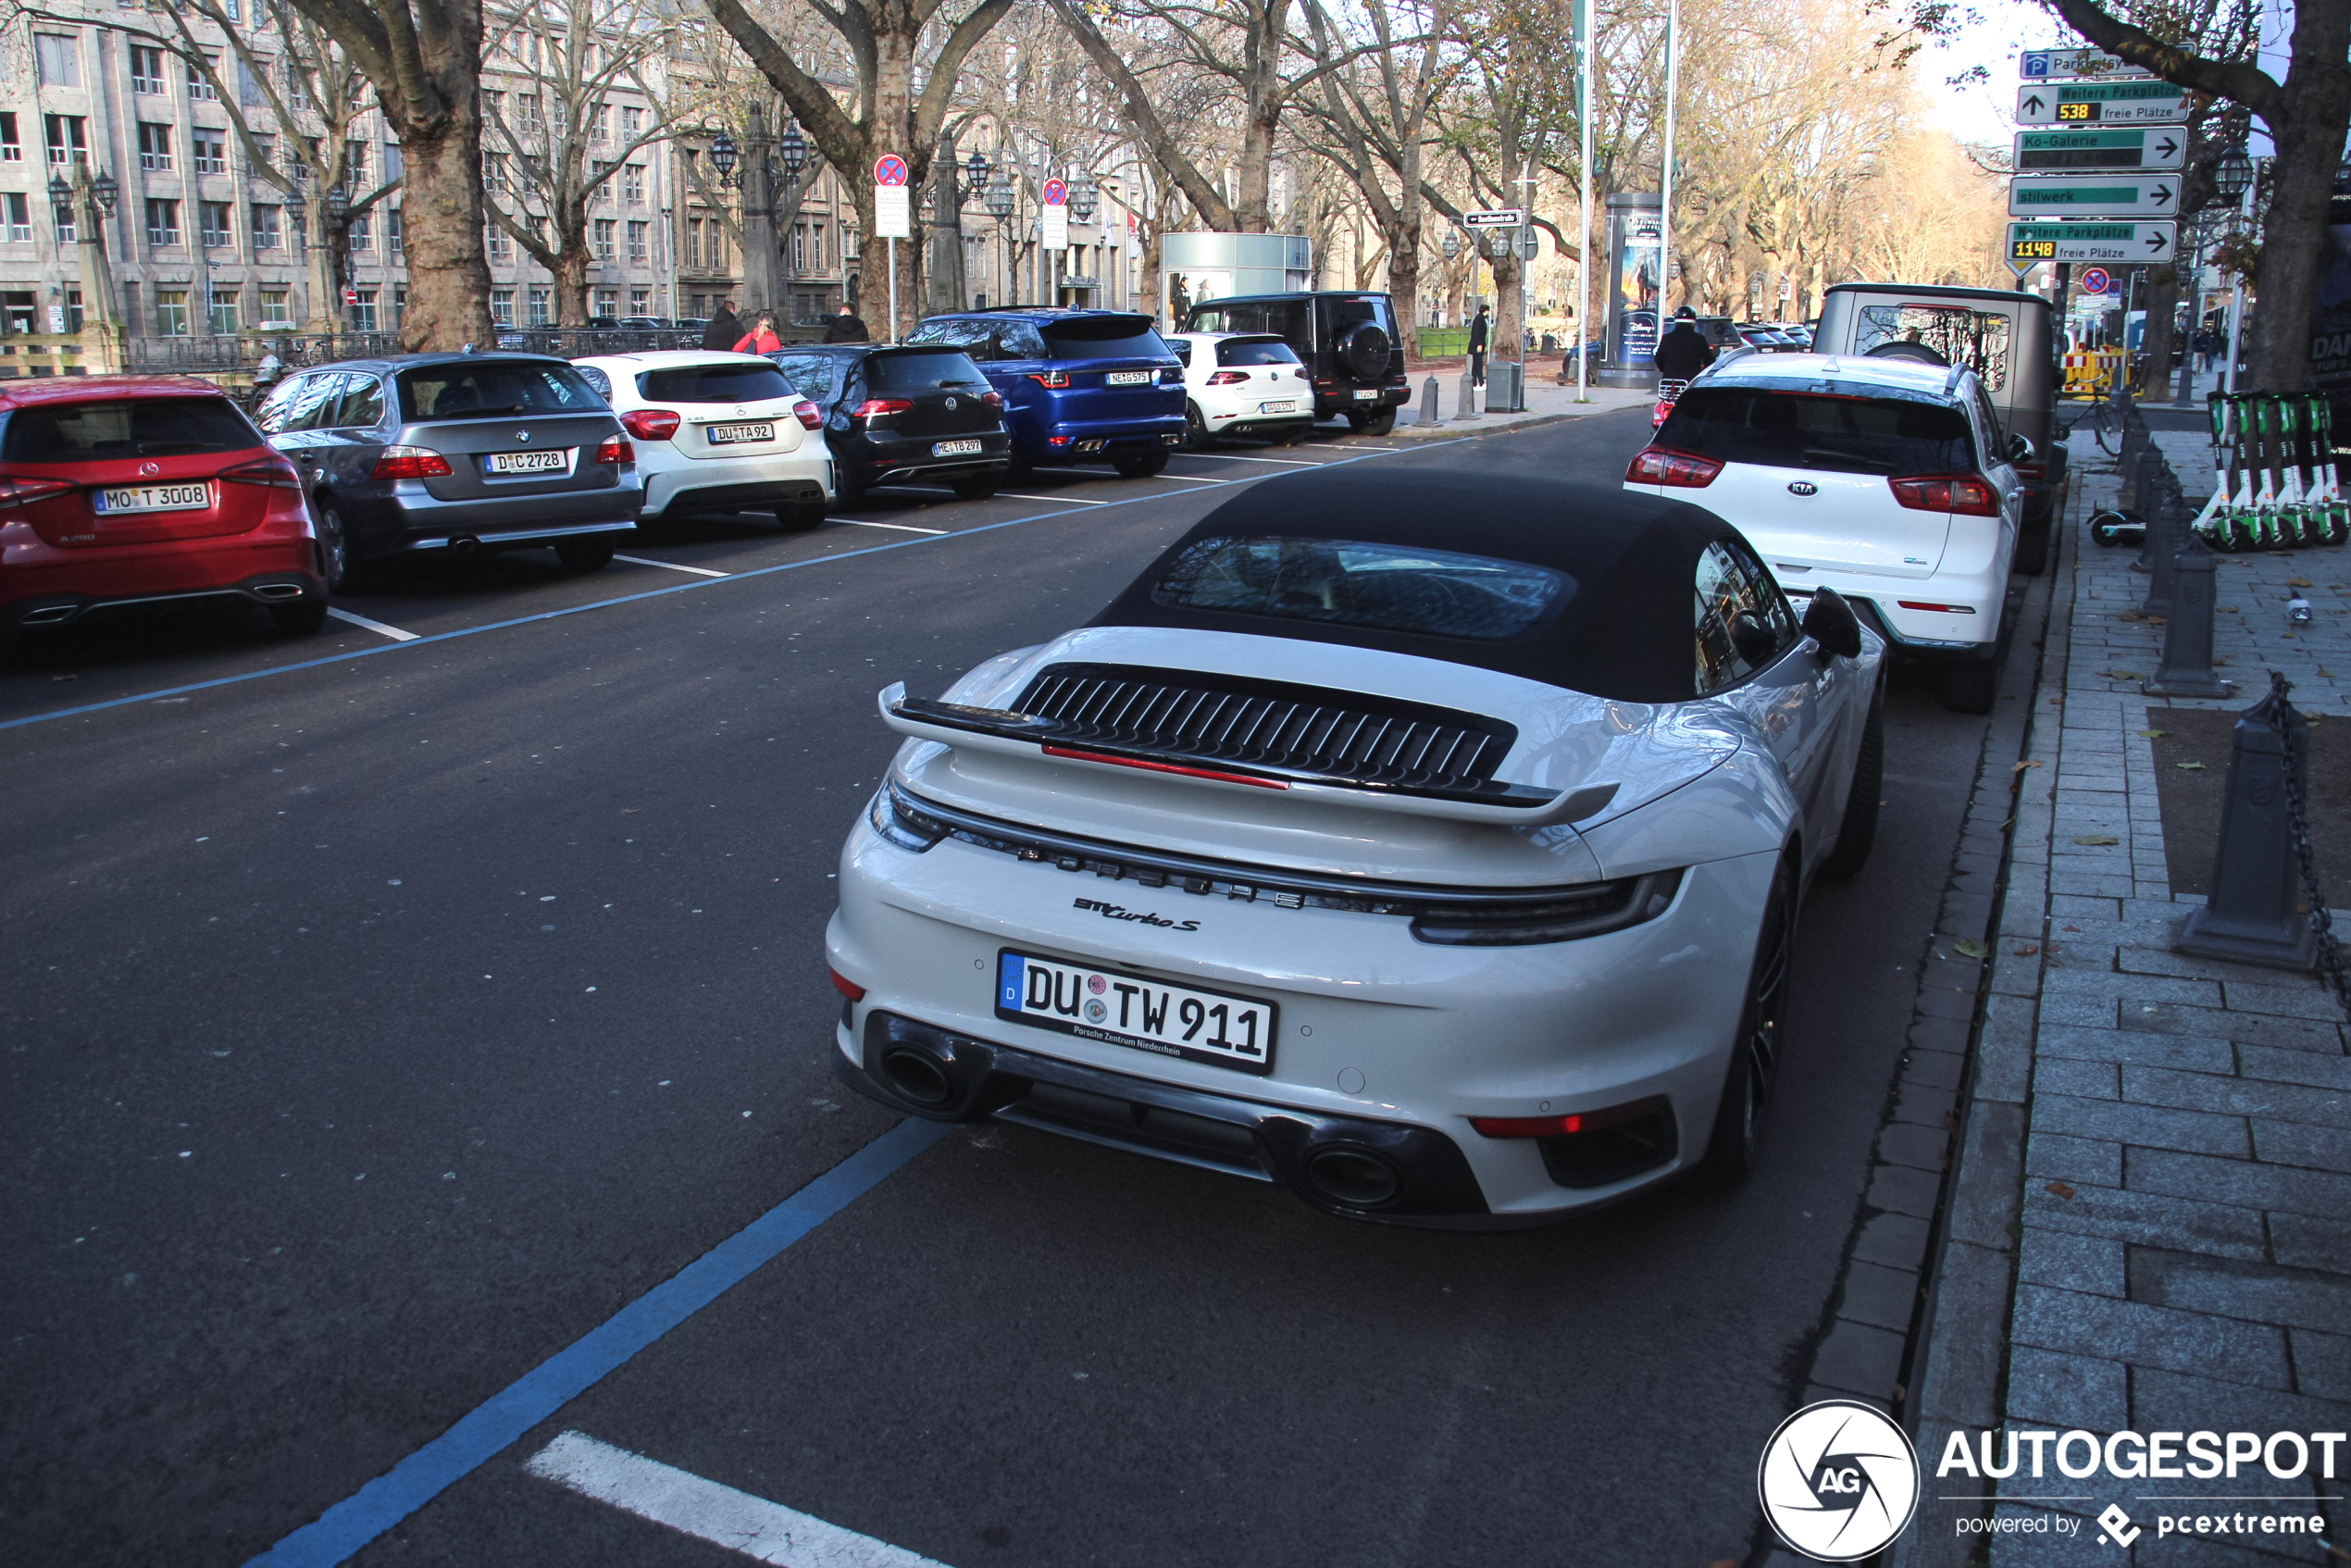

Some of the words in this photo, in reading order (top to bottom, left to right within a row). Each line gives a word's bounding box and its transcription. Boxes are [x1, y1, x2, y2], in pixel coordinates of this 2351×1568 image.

[2061, 86, 2106, 100] Weitere
[2113, 83, 2178, 100] Parkplätze
[2059, 104, 2089, 119] 538
[2105, 108, 2132, 119] freie
[2136, 107, 2173, 118] Plätze
[2024, 134, 2098, 148] Kö-Galerie
[2021, 190, 2074, 203] stilwerk
[2067, 225, 2130, 239] Parkplätze
[2016, 242, 2053, 256] 1148
[2059, 247, 2085, 257] freie
[2090, 247, 2125, 258] Plätze
[1113, 374, 1122, 382] NE
[1126, 373, 1132, 381] G
[1133, 372, 1147, 381] 575
[717, 428, 733, 440] DU
[739, 427, 753, 438] TA
[754, 426, 768, 437] 92
[938, 442, 950, 453] ME
[953, 442, 965, 452] TB
[965, 440, 979, 450] 297
[497, 455, 507, 469] D
[515, 454, 525, 467] C
[527, 453, 559, 467] 2728
[1792, 483, 1813, 493] KIA
[106, 491, 131, 508] MO
[142, 490, 154, 505] T
[159, 486, 204, 504] 3008
[70, 533, 95, 541] 200
[1172, 920, 1201, 932] S
[1005, 987, 1015, 1001] D
[1025, 964, 1082, 1017] DU
[1113, 982, 1170, 1036] TW
[1179, 997, 1262, 1057] 911
[1074, 1026, 1103, 1039] Porsche
[1104, 1032, 1136, 1047] Zentrum
[1137, 1039, 1180, 1056] Niederrhein
